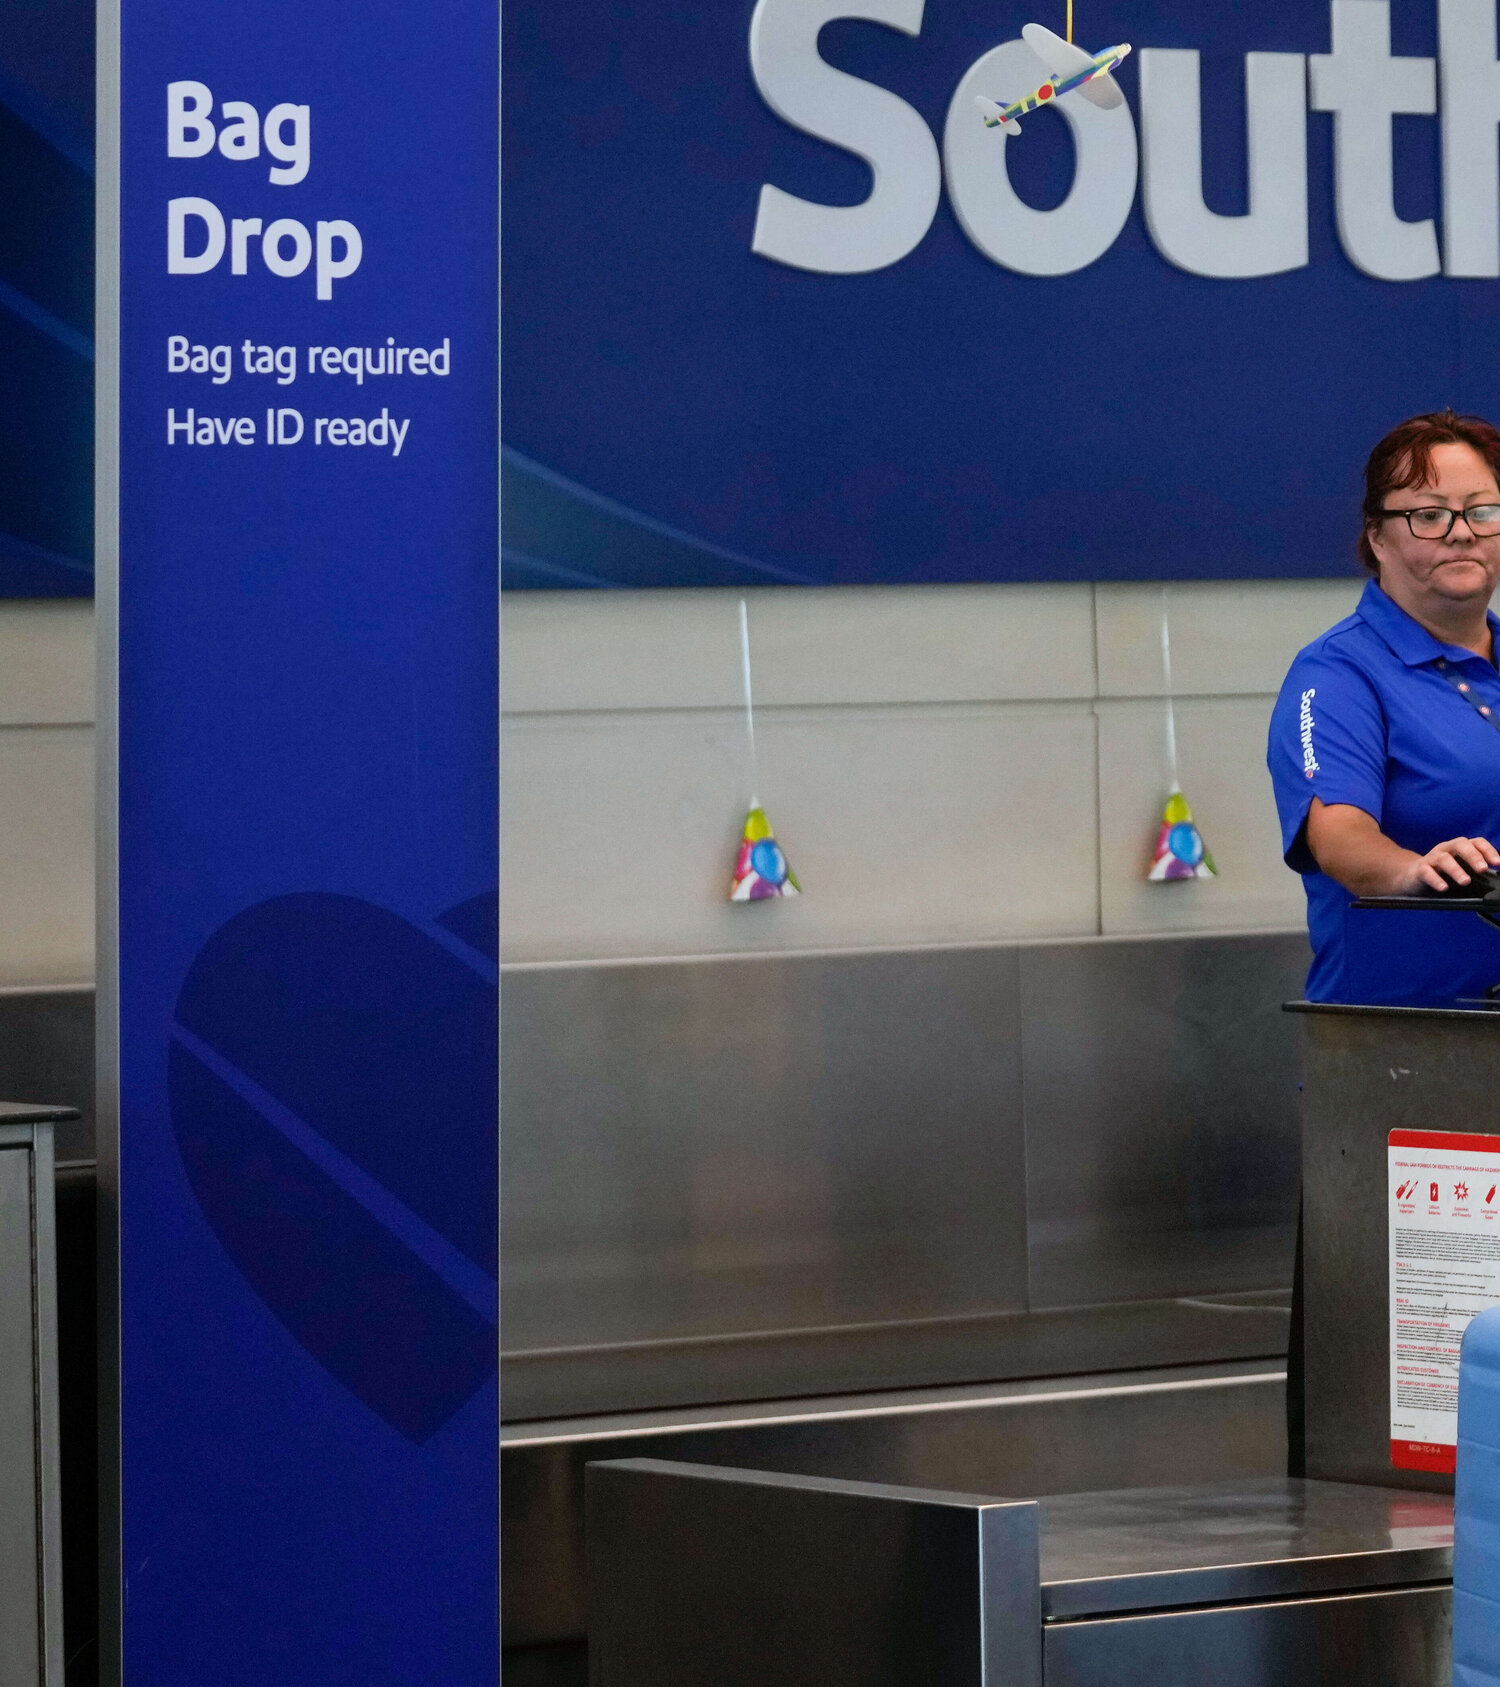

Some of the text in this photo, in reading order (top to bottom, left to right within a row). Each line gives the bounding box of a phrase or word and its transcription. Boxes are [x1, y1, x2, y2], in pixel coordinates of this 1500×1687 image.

[167, 80, 311, 186] Bag
[167, 196, 363, 301] Drop
[167, 335, 450, 386] Bag tag required
[167, 407, 411, 457] Have ID ready
[1300, 687, 1319, 772] Southwest
